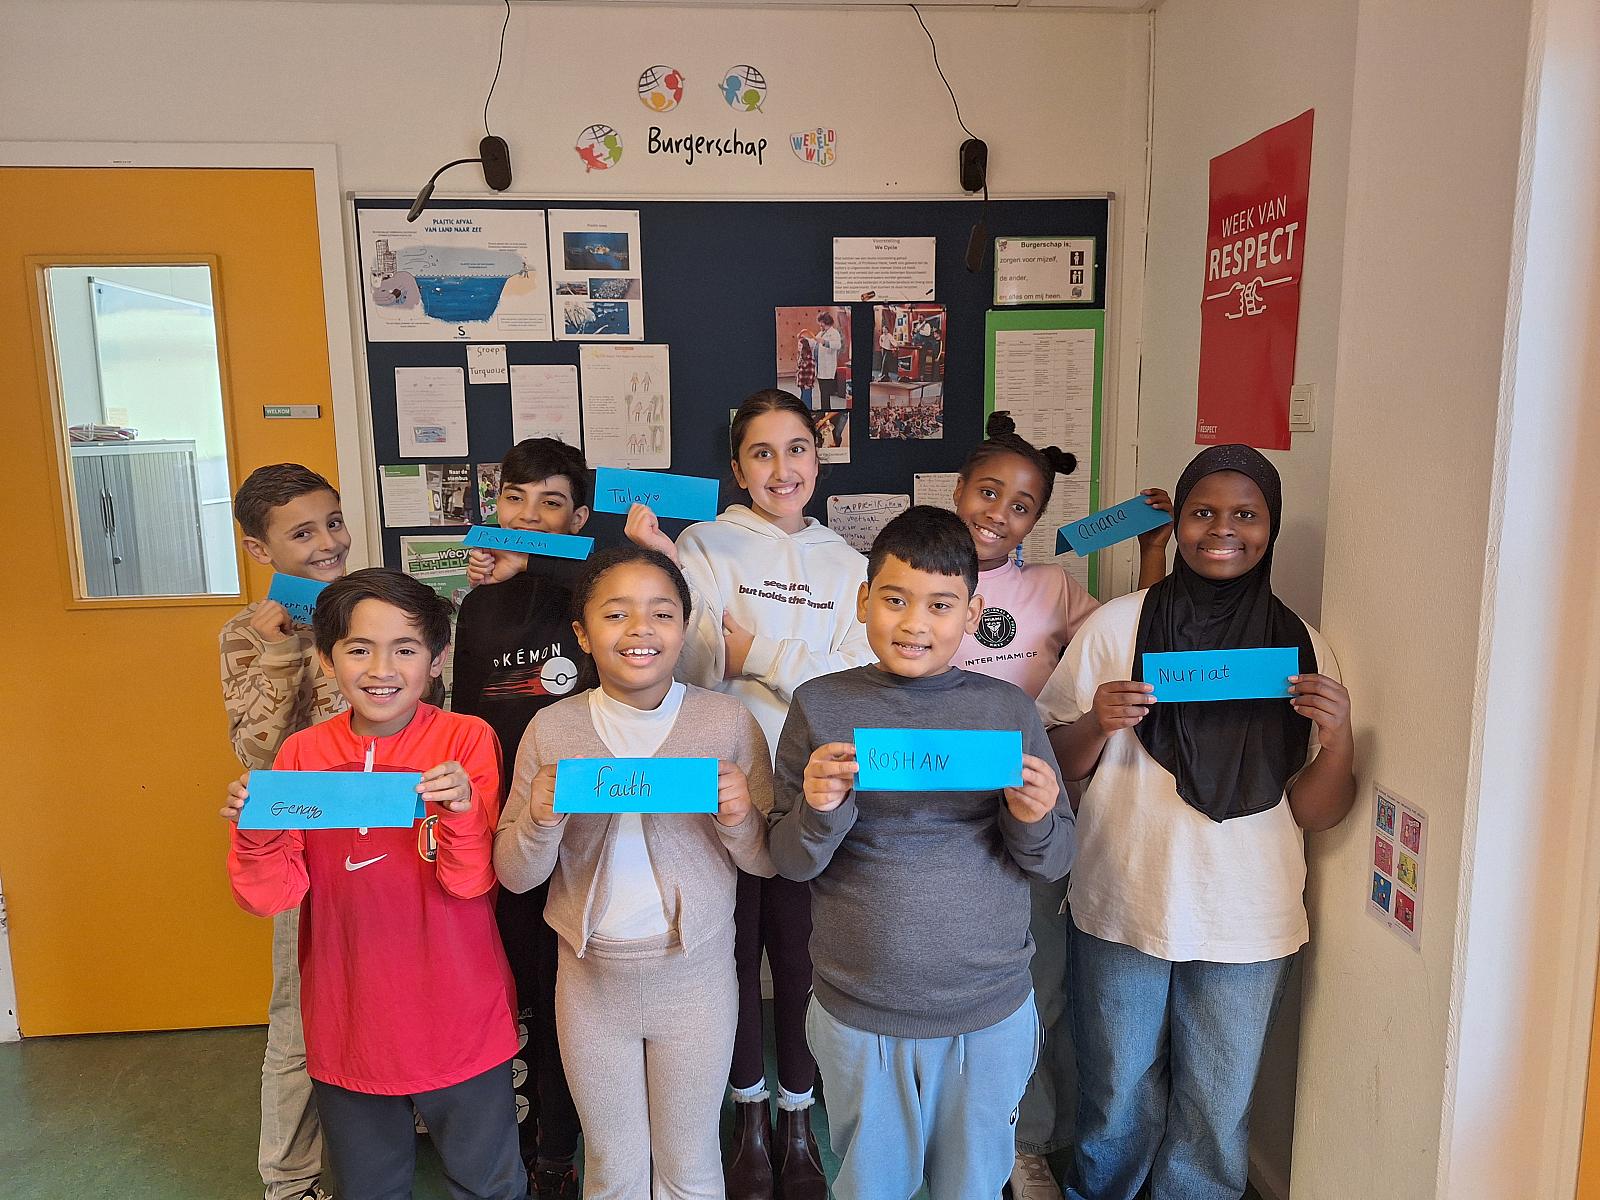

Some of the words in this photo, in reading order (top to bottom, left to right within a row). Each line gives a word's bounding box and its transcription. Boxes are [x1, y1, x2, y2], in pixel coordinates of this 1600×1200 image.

[648, 127, 768, 165] Burgerschap
[805, 147, 834, 165] WIJS
[1222, 206, 1255, 238] WEEK
[1258, 194, 1287, 225] VAN
[1021, 241, 1062, 249] Burgerschap
[1208, 221, 1299, 282] RESPECT
[607, 487, 651, 506] Tulay
[763, 580, 788, 591] sees
[788, 582, 797, 592] it
[738, 584, 758, 596] but
[757, 589, 788, 603] holds
[787, 595, 807, 605] the
[806, 599, 835, 610] small
[964, 656, 993, 667] INTER
[995, 652, 1024, 662] MIAMI
[1159, 664, 1230, 685] Nuriat
[868, 747, 949, 772] ROSHAN
